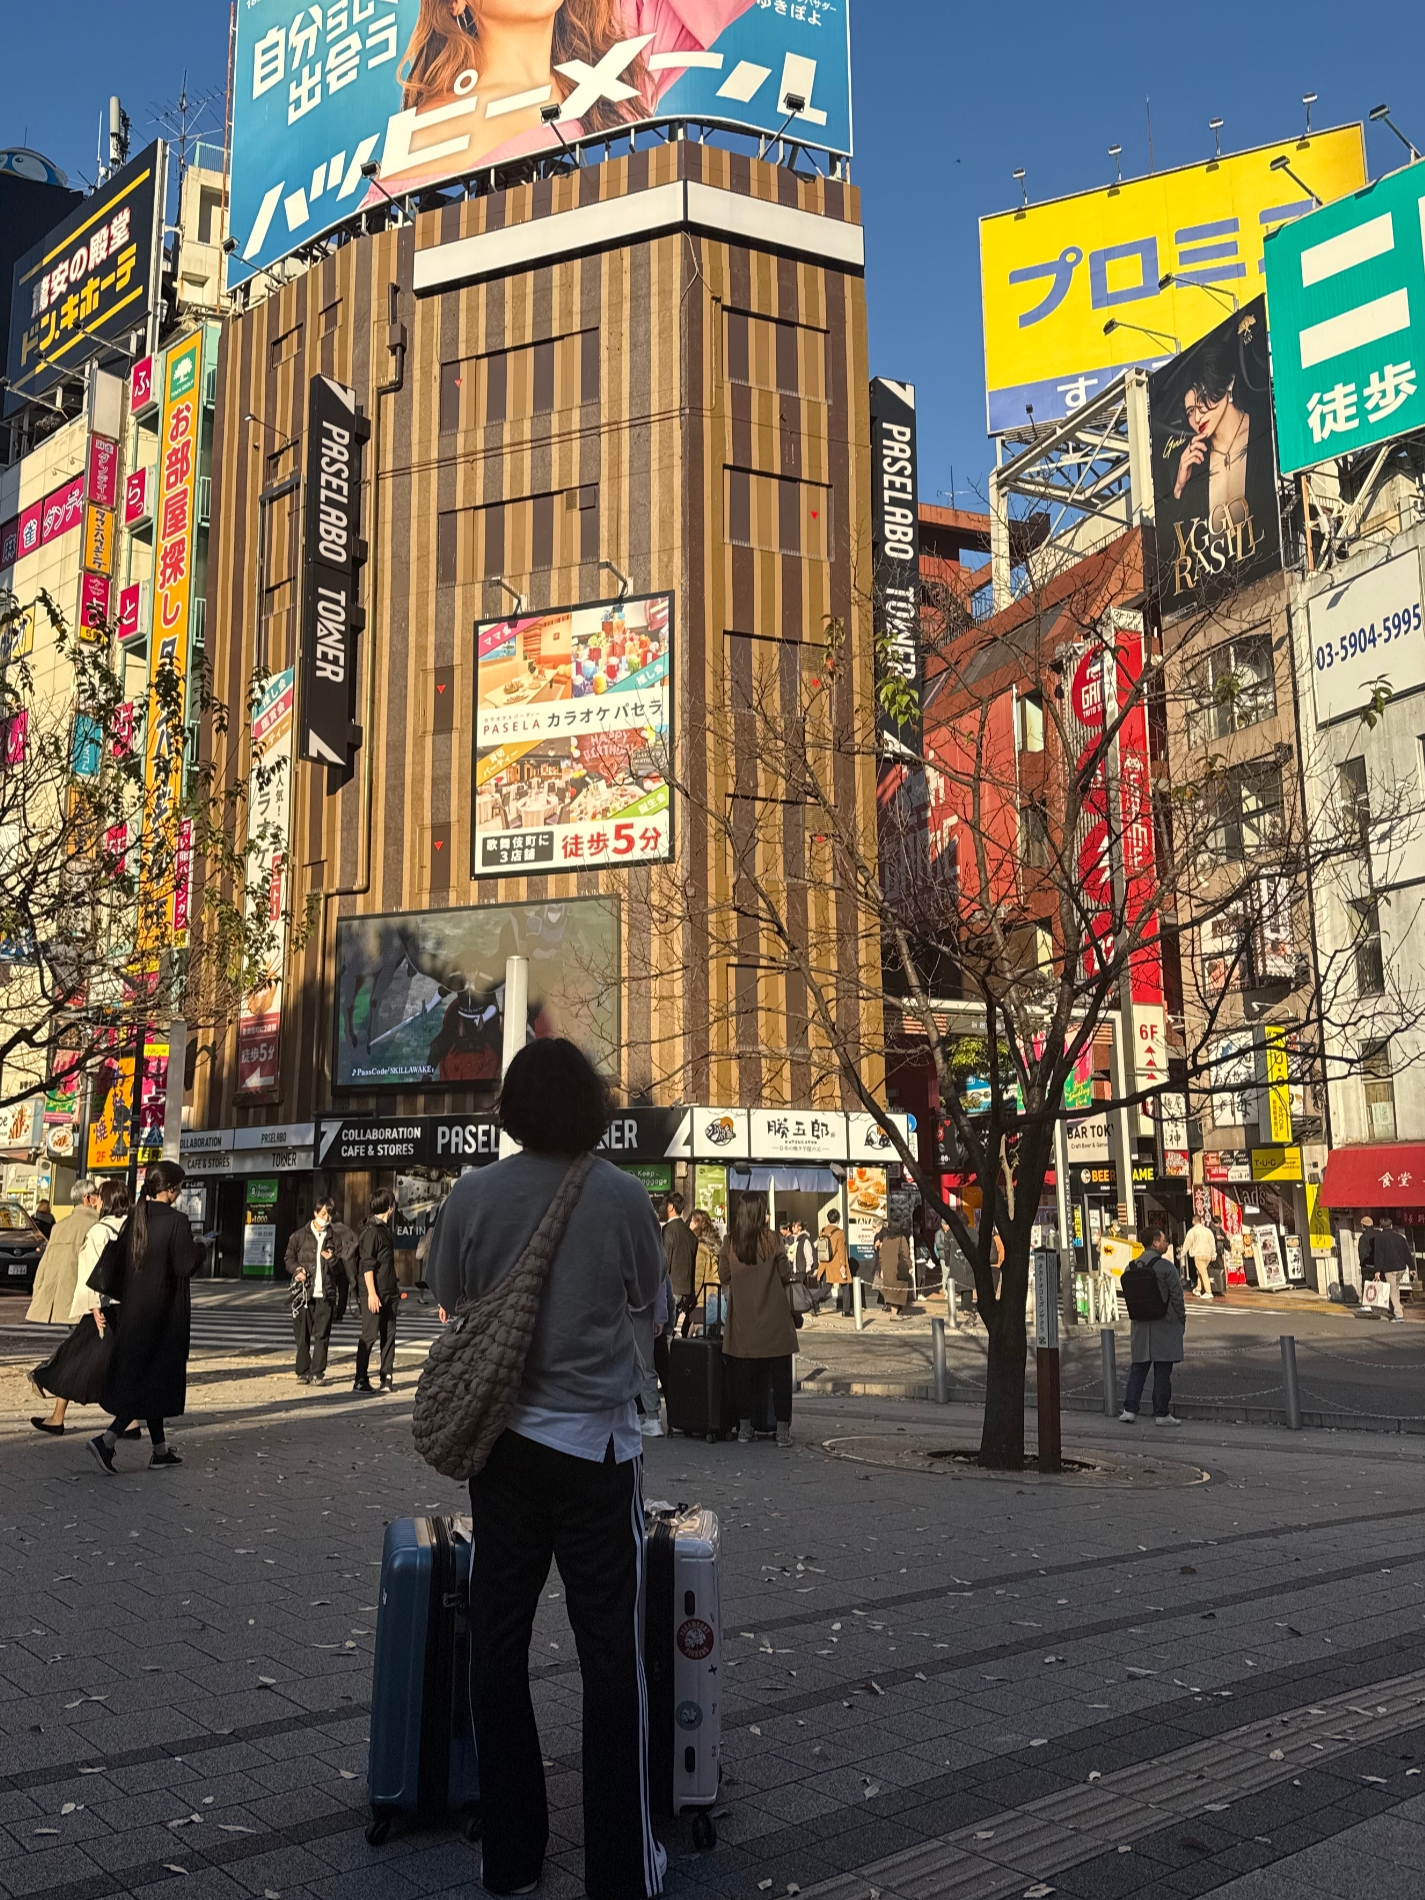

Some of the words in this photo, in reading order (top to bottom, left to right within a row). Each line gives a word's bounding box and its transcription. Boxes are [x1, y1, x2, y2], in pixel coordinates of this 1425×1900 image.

[253, 0, 399, 100] 自分らし
[288, 12, 398, 126] 出会う
[242, 33, 827, 260] ハッピーメール
[31, 207, 131, 319] 驚安の殿堂
[1306, 361, 1417, 443] 徒歩
[319, 420, 350, 563] PASELABO
[882, 422, 914, 560] PASELABO
[159, 401, 193, 629] お部屋探し
[316, 586, 346, 683] TOWER
[1316, 603, 1421, 671] 03-5904-5995
[635, 663, 665, 686] 推し会
[547, 699, 663, 728] カラオケパセラ
[483, 718, 541, 735] PASELA
[482, 750, 519, 778] パーティー
[637, 793, 668, 815] 誕生会
[486, 833, 550, 852] 歌舞伎町に
[561, 822, 663, 859] 徒歩5分
[499, 848, 536, 863] 3店舗
[1139, 1024, 1158, 1041] 6F
[241, 1042, 276, 1064] 徒歩5分
[341, 1126, 421, 1141] COLLABORATION
[437, 1123, 501, 1155] PASEL
[767, 1118, 830, 1139] 勝五郎
[1067, 1125, 1088, 1139] BAR
[180, 1136, 222, 1149] OLLABORATION
[341, 1145, 365, 1157] CAFE
[367, 1145, 375, 1156] &
[377, 1144, 414, 1156] STORES
[96, 1151, 106, 1163] 2F
[187, 1159, 202, 1169] CAFE
[208, 1157, 230, 1168] STORES
[272, 1152, 297, 1168] TOWER
[637, 1169, 655, 1177] Keep
[642, 1179, 668, 1187] aggage
[1091, 1168, 1117, 1182] BEER
[1132, 1167, 1155, 1181] AME
[1378, 1171, 1413, 1189] 食堂
[397, 1226, 413, 1236] EAT
[415, 1225, 426, 1235] IN
[1073, 1209, 1082, 1238] BEER
